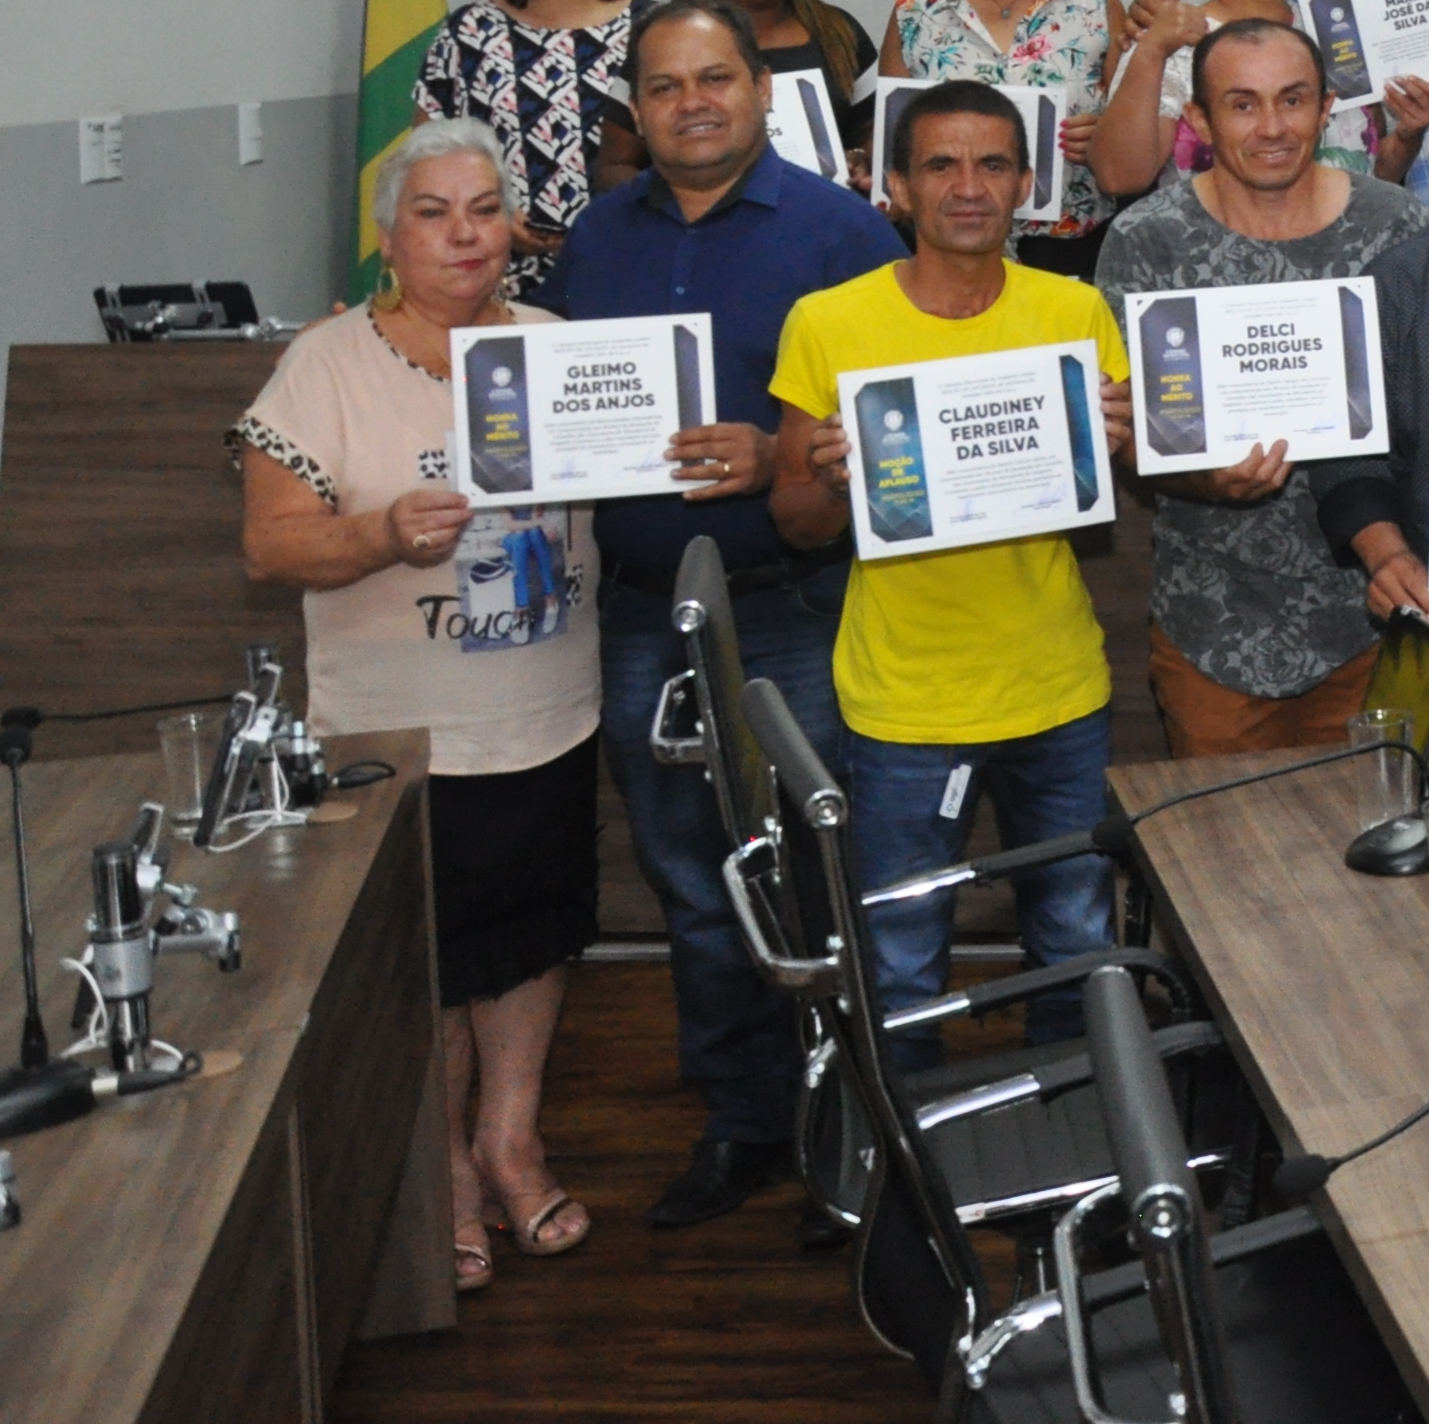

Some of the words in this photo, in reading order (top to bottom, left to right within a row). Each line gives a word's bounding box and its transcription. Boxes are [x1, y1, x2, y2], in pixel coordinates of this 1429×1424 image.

[1384, 3, 1414, 21] JOSÉ
[1394, 15, 1427, 30] SILVA
[1247, 323, 1295, 338] DELCI
[1222, 338, 1322, 357] RODRIGUES
[567, 362, 636, 379] GLEIMO
[1240, 356, 1307, 373] MORAIS
[564, 378, 642, 395] MARTINS
[553, 399, 590, 413] DOS
[595, 394, 655, 410] ANJOS
[939, 396, 1044, 424] CLAUDINEY
[951, 417, 1039, 441] FERREIRA
[957, 444, 983, 460] DA
[988, 436, 1039, 455] SILVA
